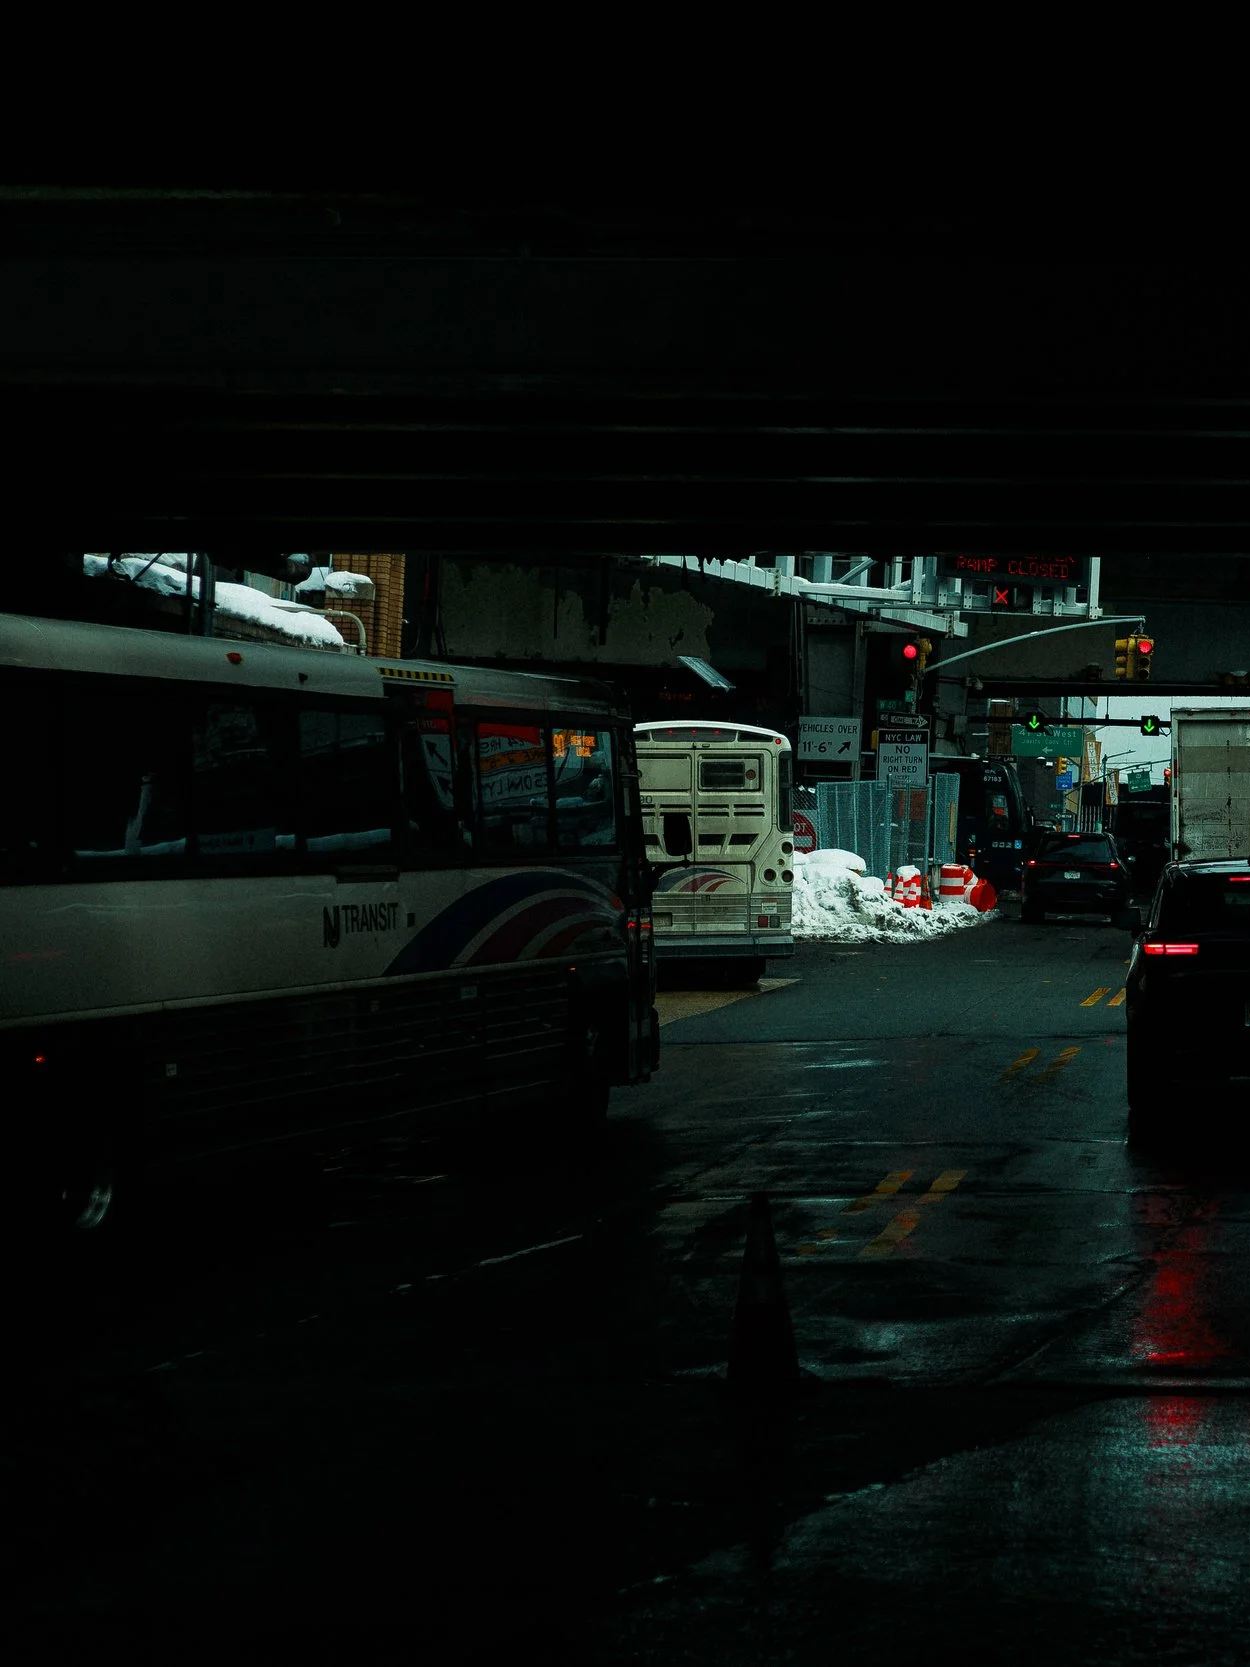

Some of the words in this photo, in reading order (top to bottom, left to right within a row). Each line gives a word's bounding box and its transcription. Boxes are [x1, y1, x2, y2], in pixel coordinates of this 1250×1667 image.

[956, 556, 998, 573] RAMP
[1008, 560, 1069, 579] CLOSED
[799, 724, 834, 733] VEHICLES
[838, 725, 858, 734] OVER
[1053, 729, 1077, 738] West
[885, 734, 902, 742] NYC
[905, 734, 922, 742] LAW
[896, 746, 911, 754] NO
[883, 756, 902, 764] RIGHT
[905, 756, 923, 764] TURN
[342, 902, 399, 933] TRANSIT
